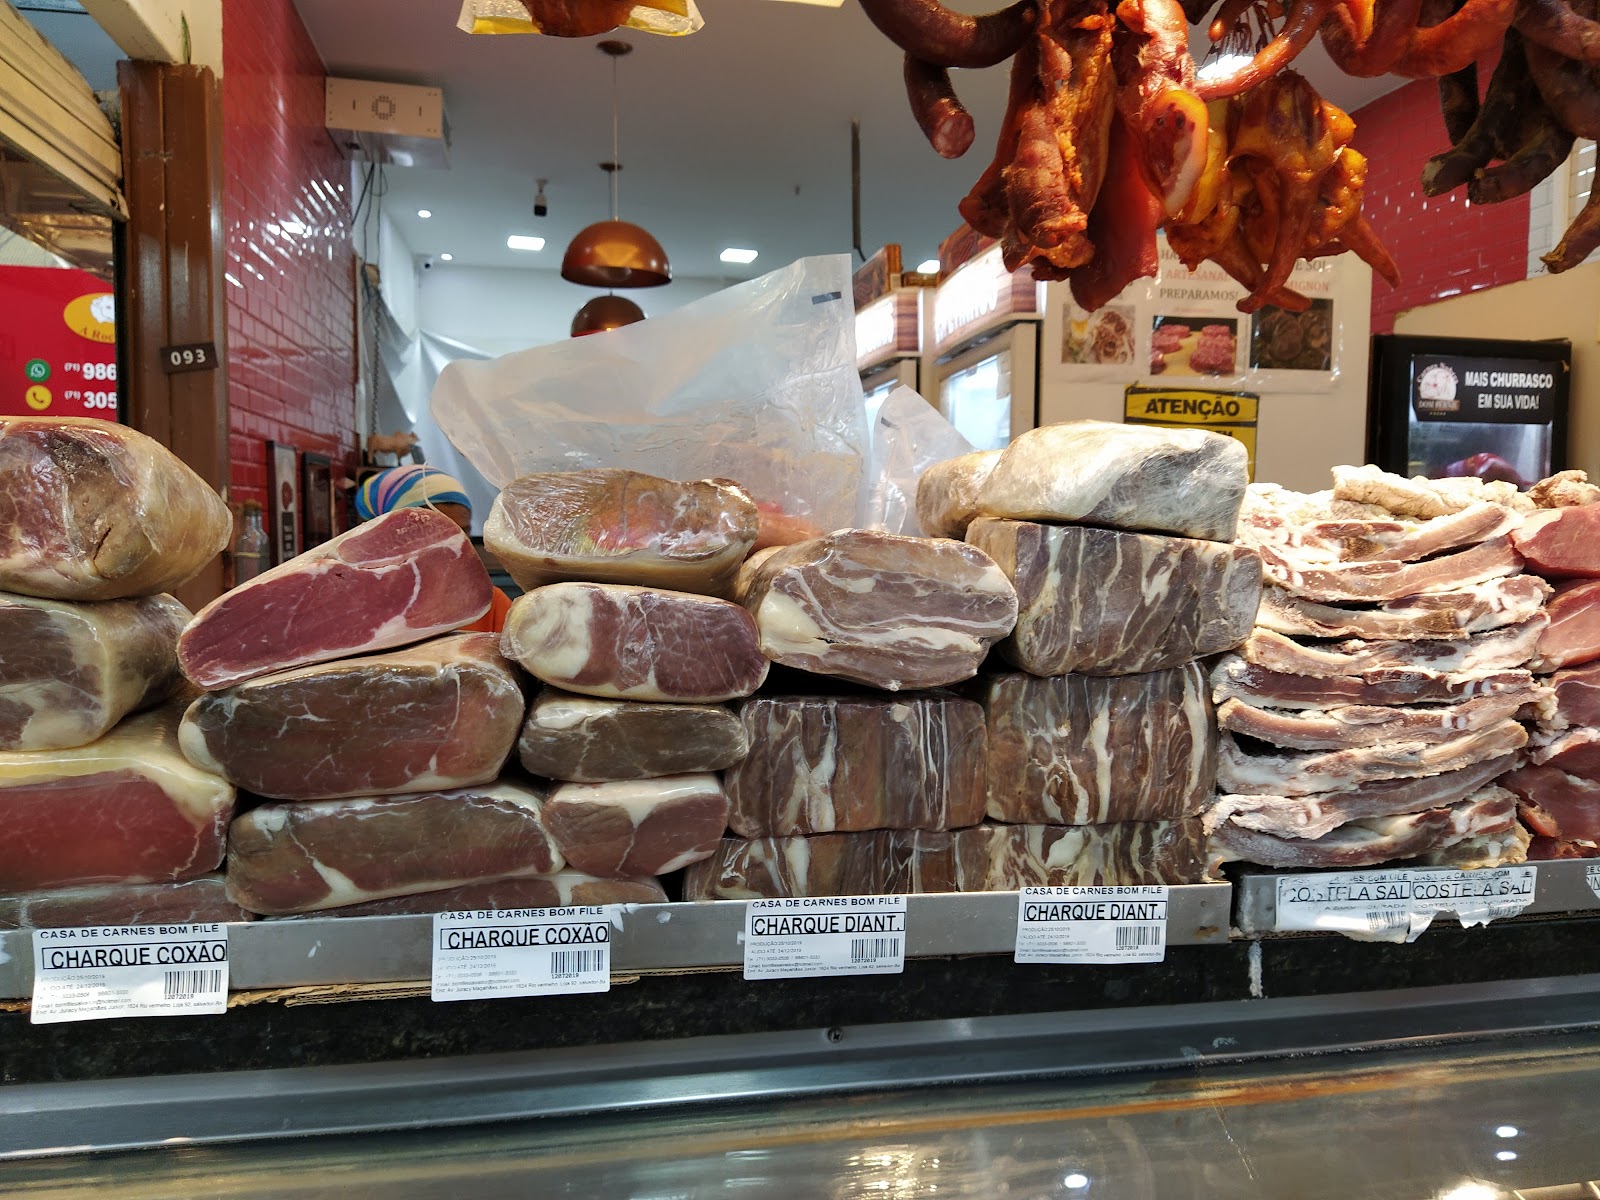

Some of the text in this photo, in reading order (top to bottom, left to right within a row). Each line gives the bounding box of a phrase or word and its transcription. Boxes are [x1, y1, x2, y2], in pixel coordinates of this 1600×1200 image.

[1160, 288, 1239, 301] PREPARAMOS!
[170, 349, 206, 366] 093
[1465, 371, 1554, 388] MAIS CHURRASCO
[1145, 397, 1240, 420] ATENÇÃO
[1478, 394, 1540, 410] EM SUA VIDA!
[1025, 887, 1052, 895] CASA
[1072, 887, 1114, 895] CARNES
[1376, 884, 1410, 900] SAL
[752, 900, 782, 908] CASA
[804, 898, 848, 907] CARNES
[851, 898, 874, 906] BOM
[440, 911, 472, 920] CASA
[478, 911, 493, 919] DE
[497, 910, 546, 918] CARNES
[550, 908, 575, 916] BOM
[1026, 904, 1162, 921] CHARQUE DIANT.
[40, 930, 76, 939] CASA
[82, 929, 98, 938] DE
[102, 927, 154, 936] CARNES
[160, 926, 188, 934] BOM
[754, 915, 900, 935] CHARQUE DIANT.
[448, 924, 608, 949] CHARQUE COXÃO
[52, 942, 226, 969] CHARQUE COXÃO
